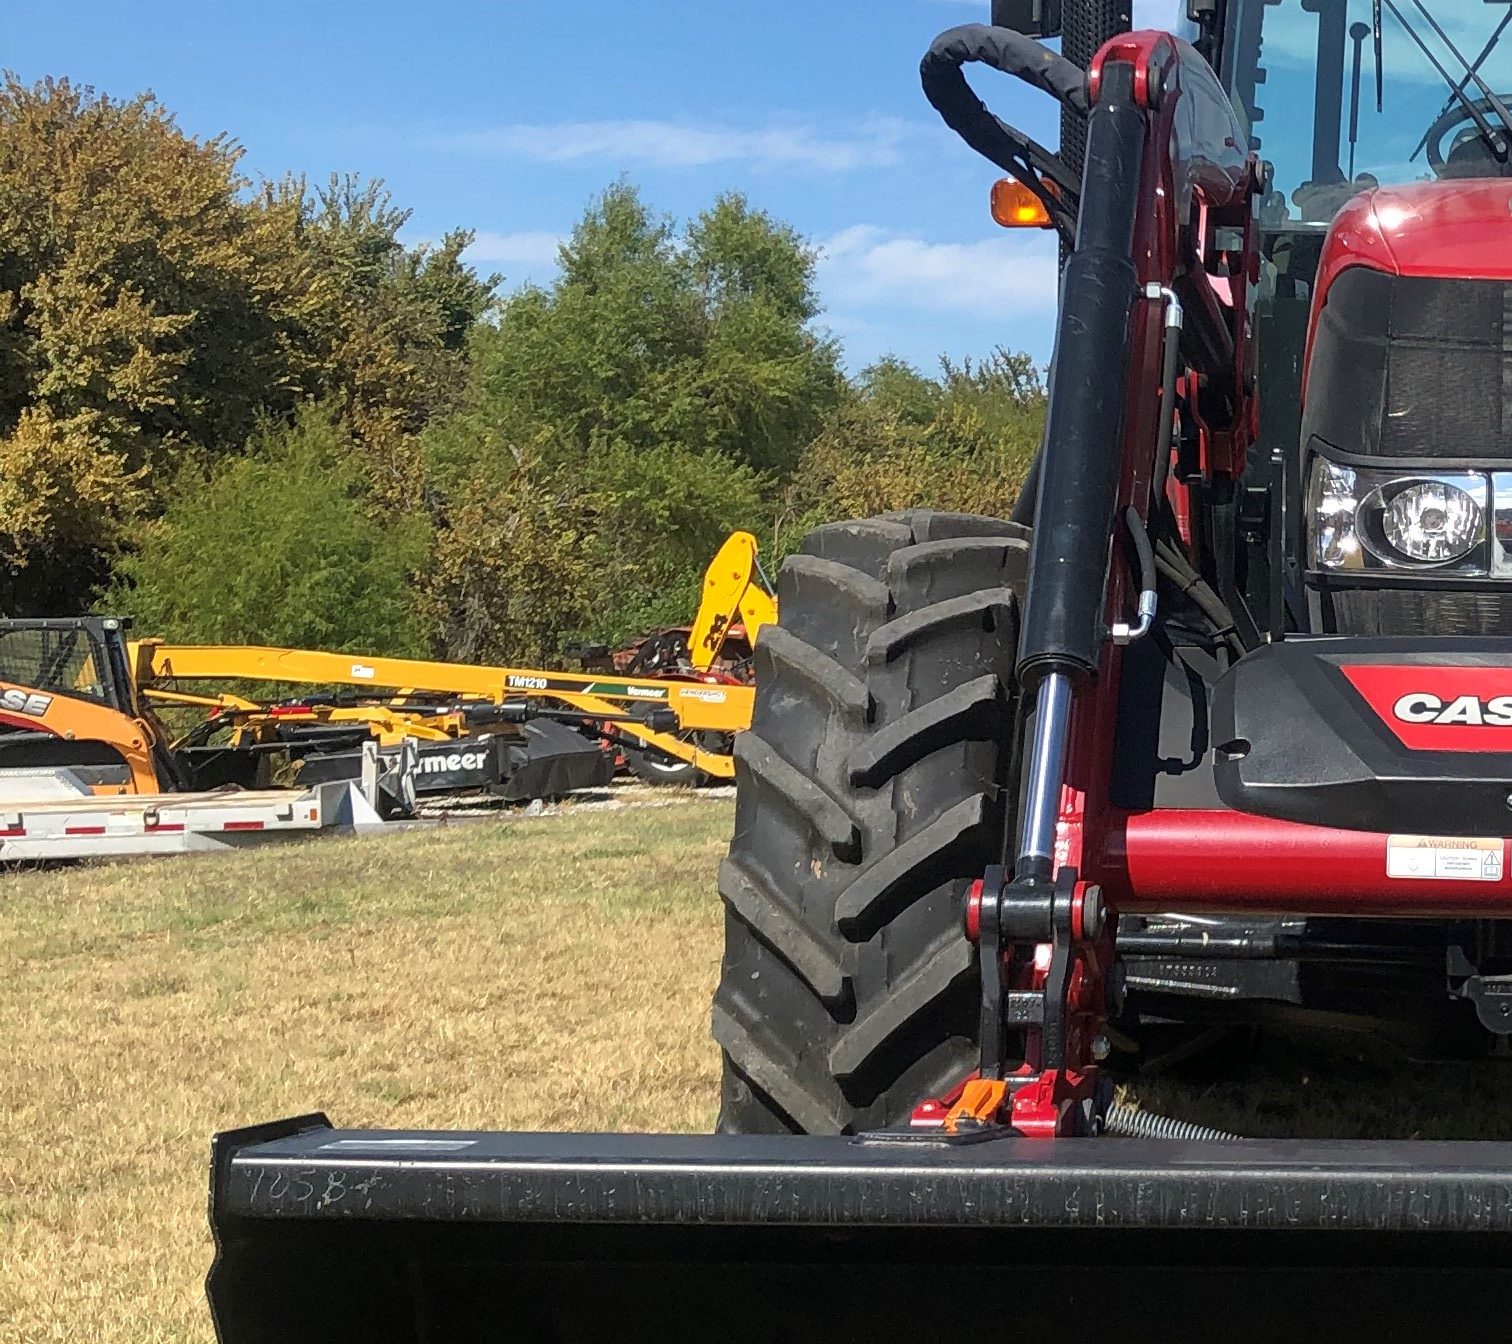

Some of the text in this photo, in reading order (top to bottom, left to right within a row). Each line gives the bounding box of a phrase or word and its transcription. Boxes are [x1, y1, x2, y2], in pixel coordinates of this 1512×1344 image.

[508, 675, 547, 690] TM1210
[626, 686, 666, 698] Vermeer
[1427, 839, 1478, 850] WARNING
